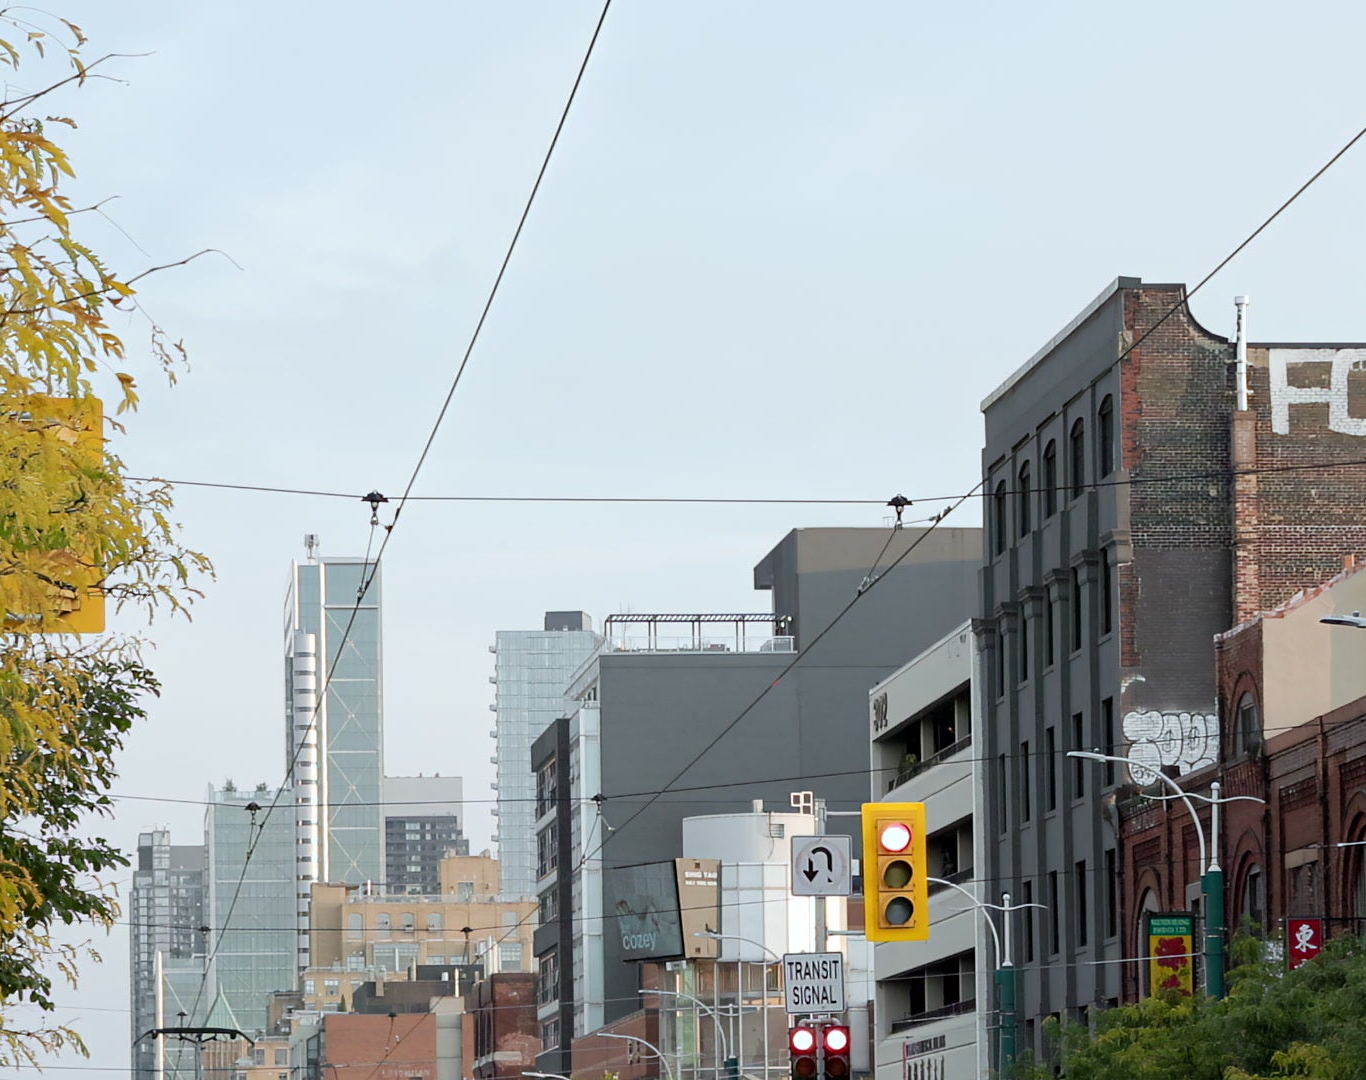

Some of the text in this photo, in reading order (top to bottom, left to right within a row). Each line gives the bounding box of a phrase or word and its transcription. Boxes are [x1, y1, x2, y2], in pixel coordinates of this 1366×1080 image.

[622, 932, 656, 951] cozey
[787, 960, 839, 980] TRANSIT
[792, 985, 838, 1005] SIGNAL
